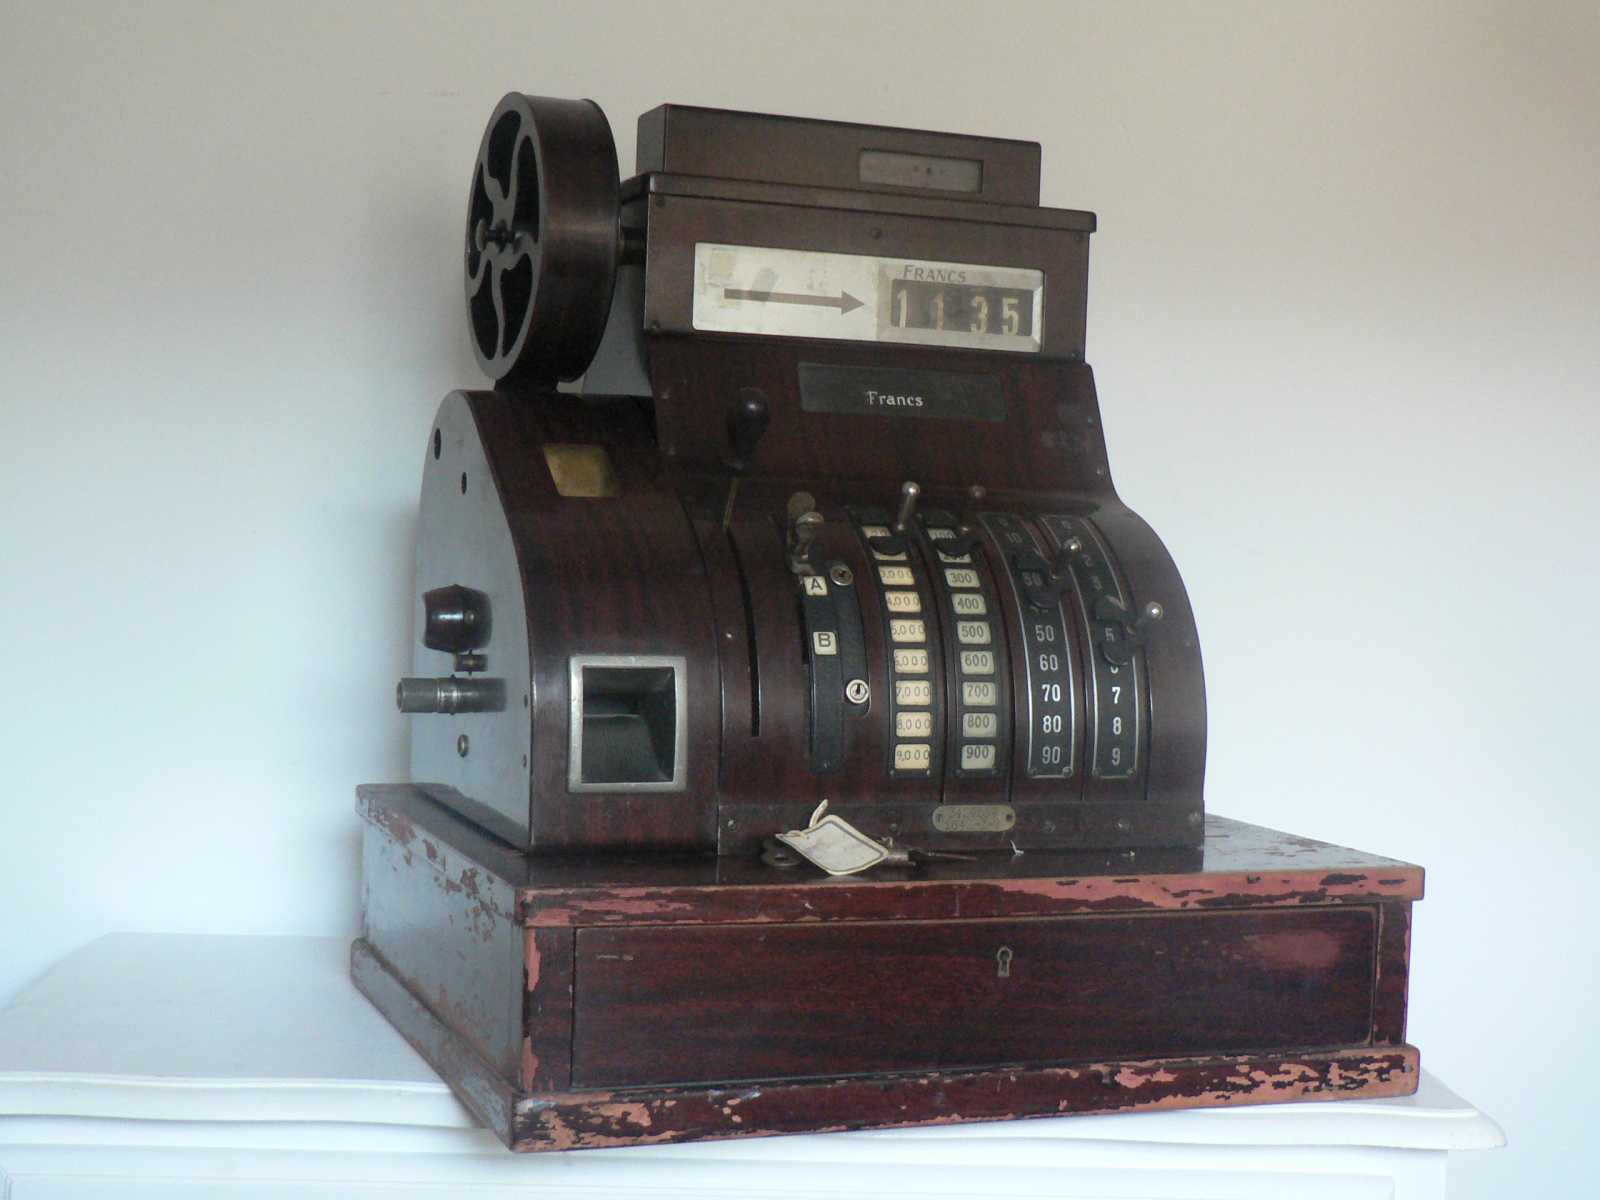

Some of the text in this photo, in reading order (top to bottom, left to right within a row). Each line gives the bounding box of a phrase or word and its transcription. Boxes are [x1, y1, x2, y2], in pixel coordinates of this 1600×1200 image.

[903, 265, 966, 283] FRANCS
[866, 391, 923, 407] Francs
[810, 577, 823, 591] A
[949, 572, 972, 584] 300
[957, 598, 979, 610] 400
[818, 632, 831, 647] B
[961, 625, 984, 638] 500
[1035, 624, 1055, 642] 50
[964, 654, 988, 667] 600
[1039, 653, 1059, 671] 60
[966, 684, 989, 698] 700
[1041, 683, 1061, 702] 70
[1111, 686, 1121, 704] 7
[967, 715, 990, 728] 800
[1042, 714, 1062, 733] 80
[1112, 716, 1122, 735] 8
[966, 746, 989, 759] 900
[1042, 745, 1061, 764] 90
[1111, 747, 1121, 766] 9
